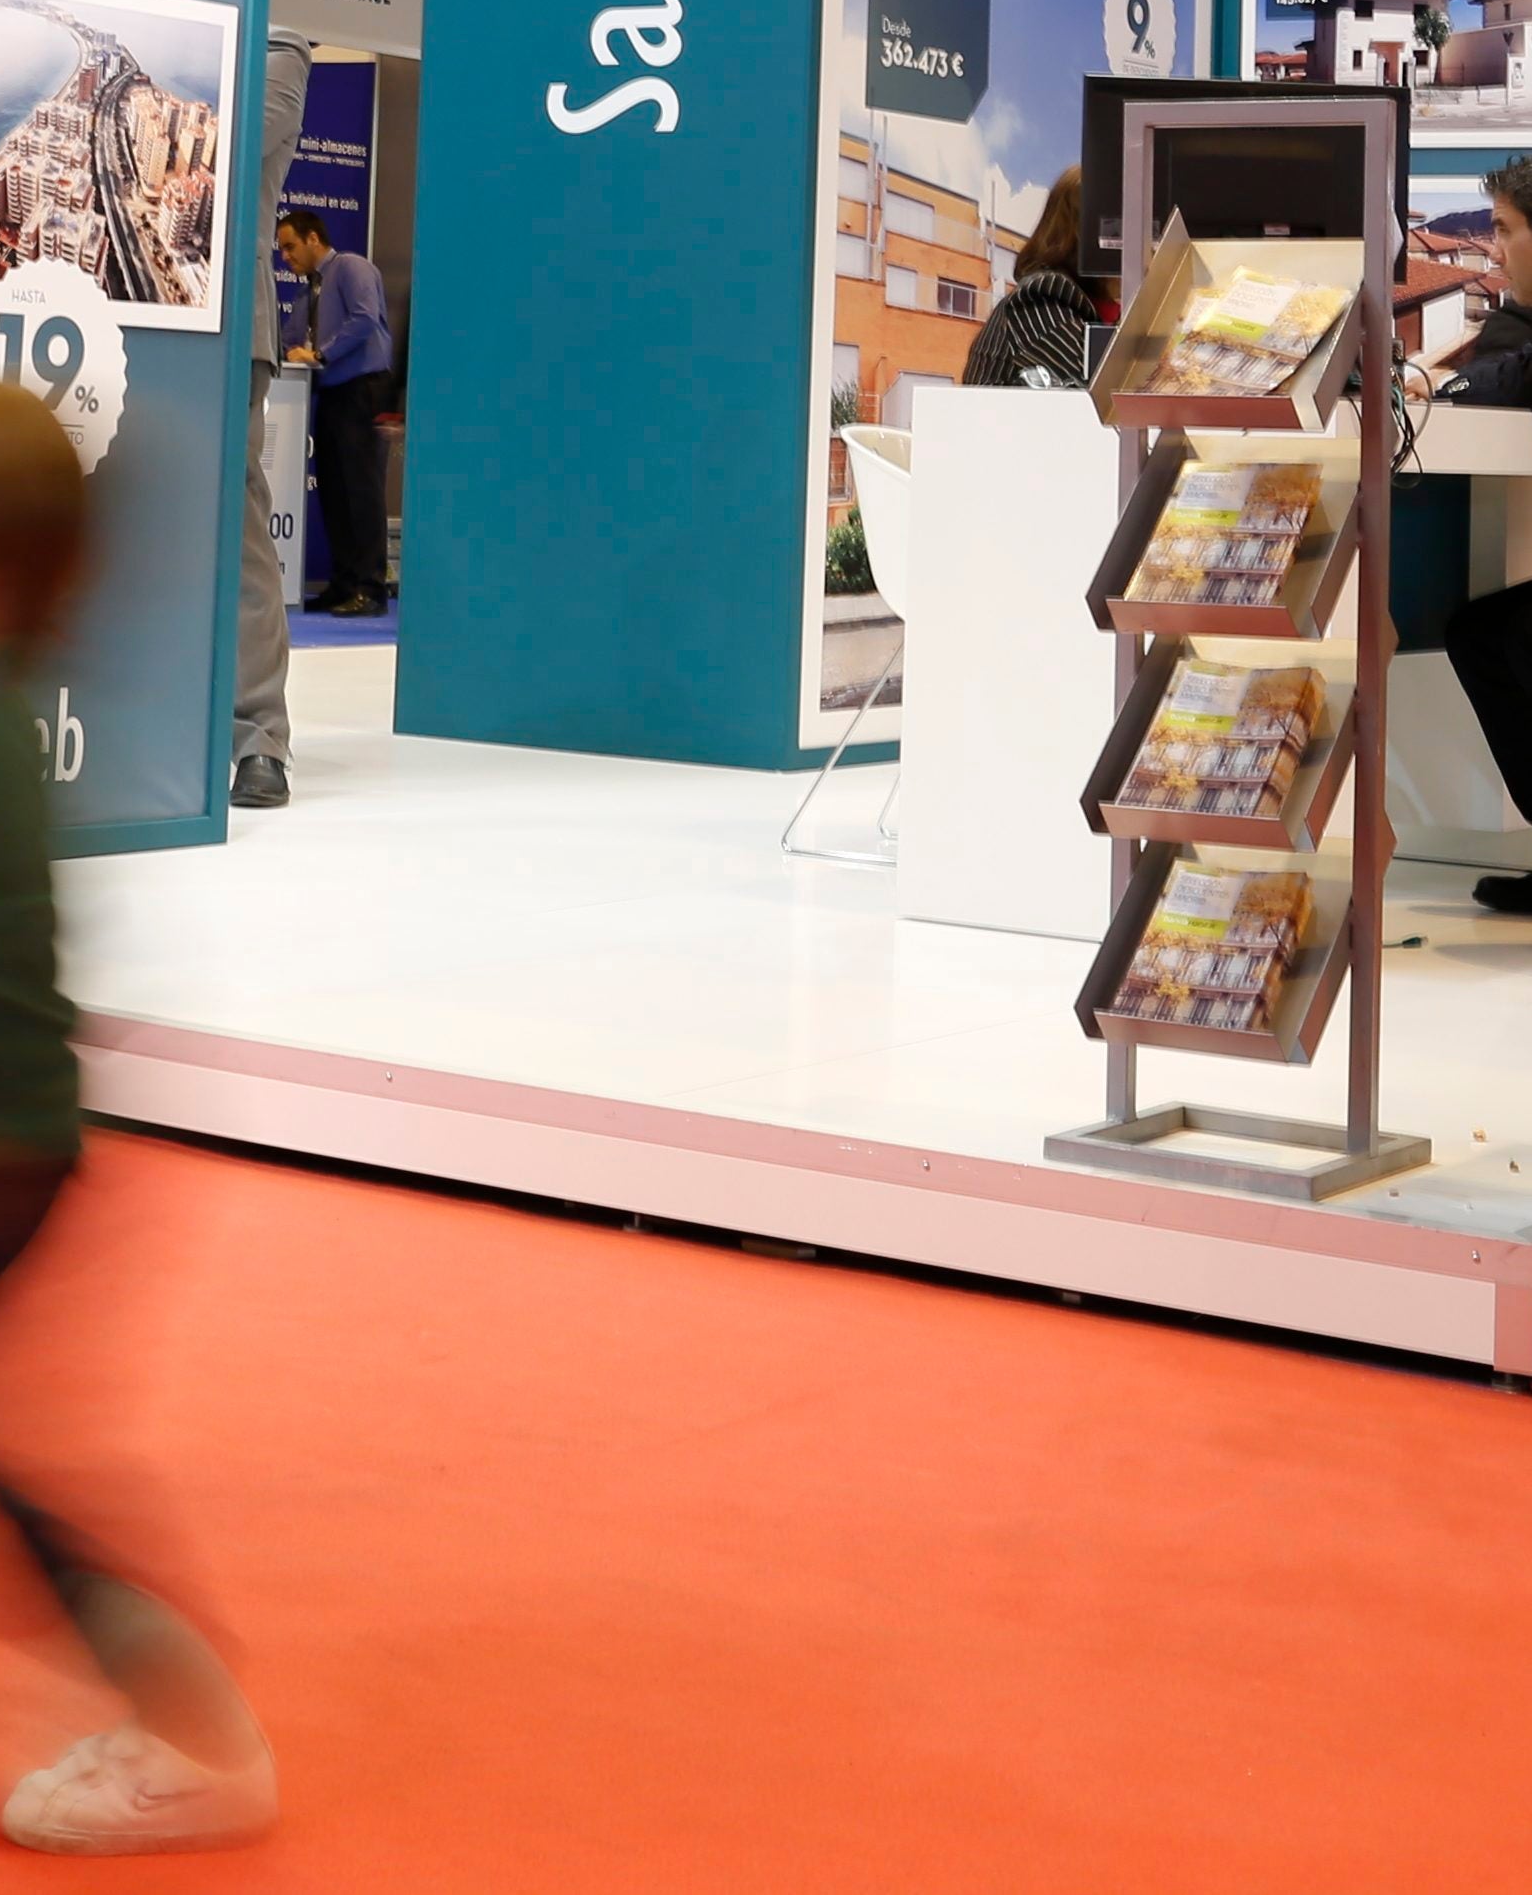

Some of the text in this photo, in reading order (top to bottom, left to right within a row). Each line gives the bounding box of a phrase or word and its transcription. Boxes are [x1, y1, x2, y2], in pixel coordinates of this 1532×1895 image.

[882, 15, 911, 38] Desde
[881, 37, 964, 78] 362.473 €
[12, 289, 46, 304] HASTA
